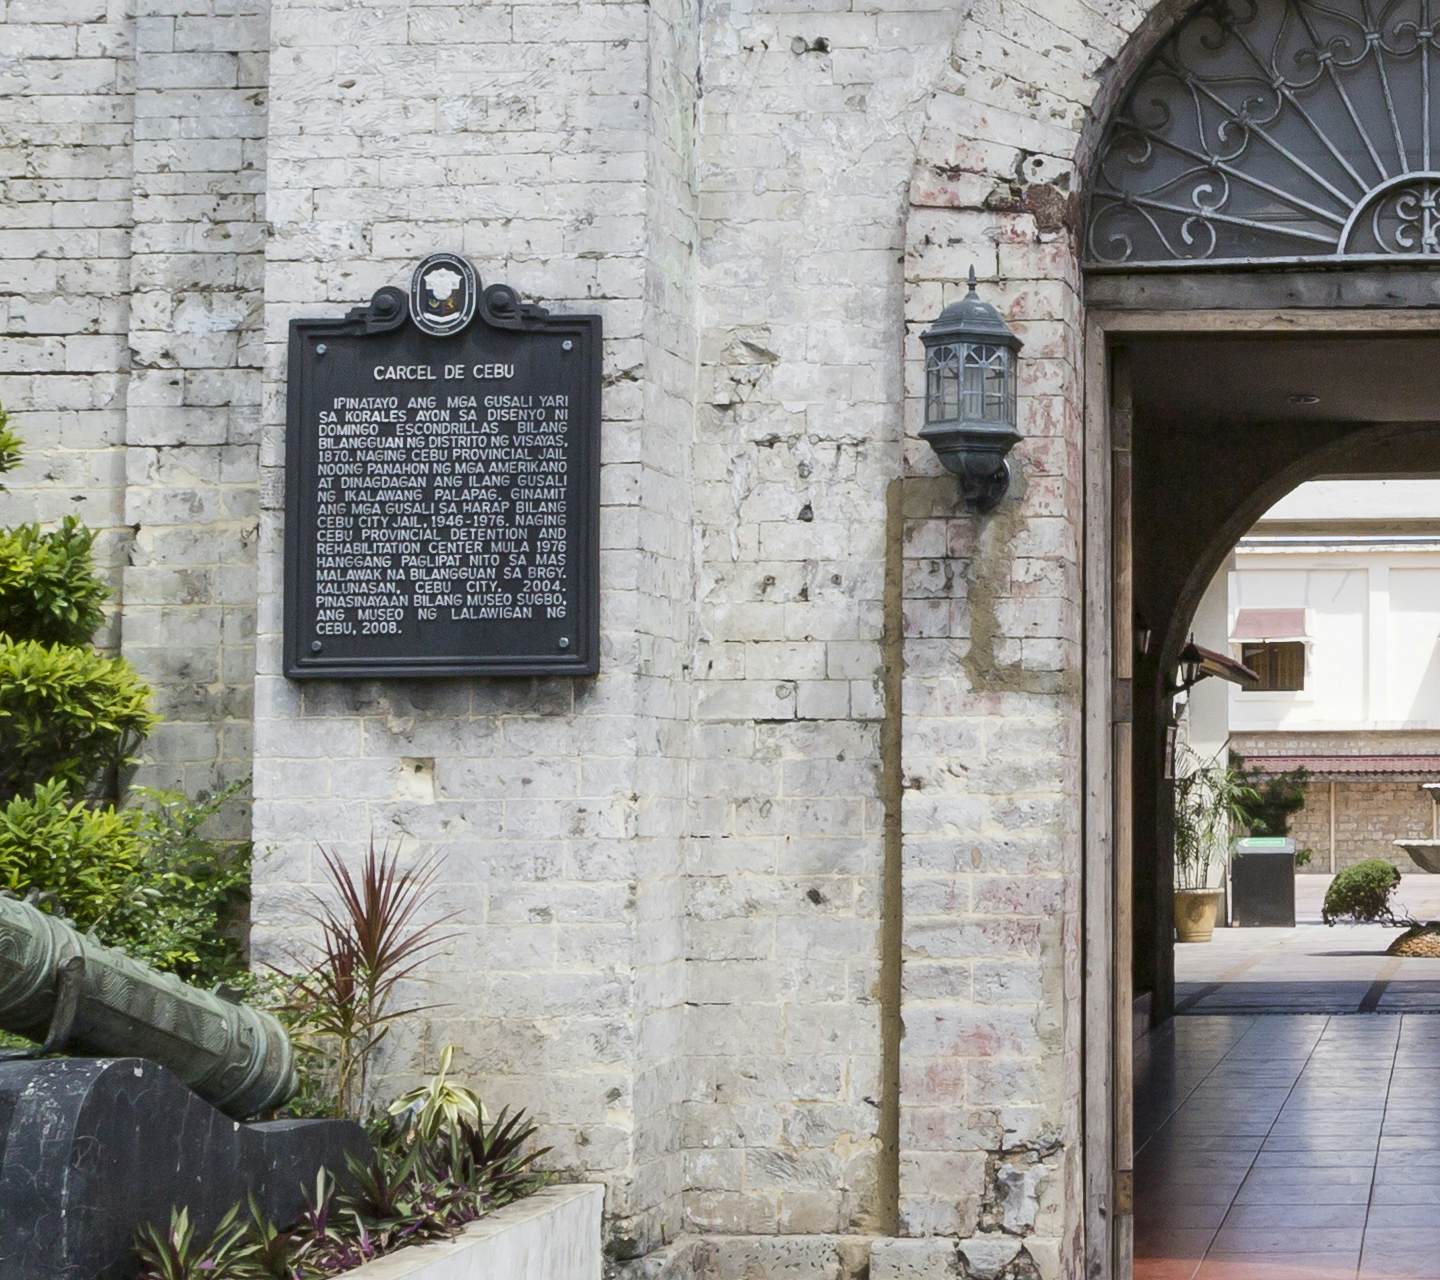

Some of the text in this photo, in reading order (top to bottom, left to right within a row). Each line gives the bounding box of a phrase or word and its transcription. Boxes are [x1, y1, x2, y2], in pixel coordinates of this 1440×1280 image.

[373, 364, 515, 380] CARCEL DE CEBU
[333, 395, 569, 411] IPINATAYO ANG MGA GUSALI YARI
[318, 408, 569, 424] SA KORALES AYON SA DISENYO NI
[318, 421, 568, 437] DOMINGO ESCONDRILLAS BILANG
[318, 434, 569, 450] BILANGGUAN NG DISTRITO NG VISAYAS,
[318, 447, 567, 463] 1870. NAGING CEBU PROVINCIAL JAIL
[317, 461, 568, 476] NOONG PANAHON NG MGA AMERIKANO
[317, 474, 568, 490] AT DINAGDAGAN ANG ILANG GUSALI
[317, 488, 566, 503] NG IKALAWANG PALAPAG. GINAMIT
[316, 527, 567, 543] CEBU PROVINCIAL DETENTION AND
[316, 540, 567, 556] REHABILITATION CENTER MULA 1976
[316, 553, 567, 569] HANGGANG PAGLIPAT NITO SA MAS
[316, 567, 567, 582] MALAWAK NA BILANGGUAN SA BRGY.
[315, 593, 567, 608] PINASINAYAAN BILANG MUSEO SUGBO,
[316, 607, 567, 622] ANG MUSEO NG LALAWIGAN NG
[315, 622, 403, 636] CEBU, 2008.
